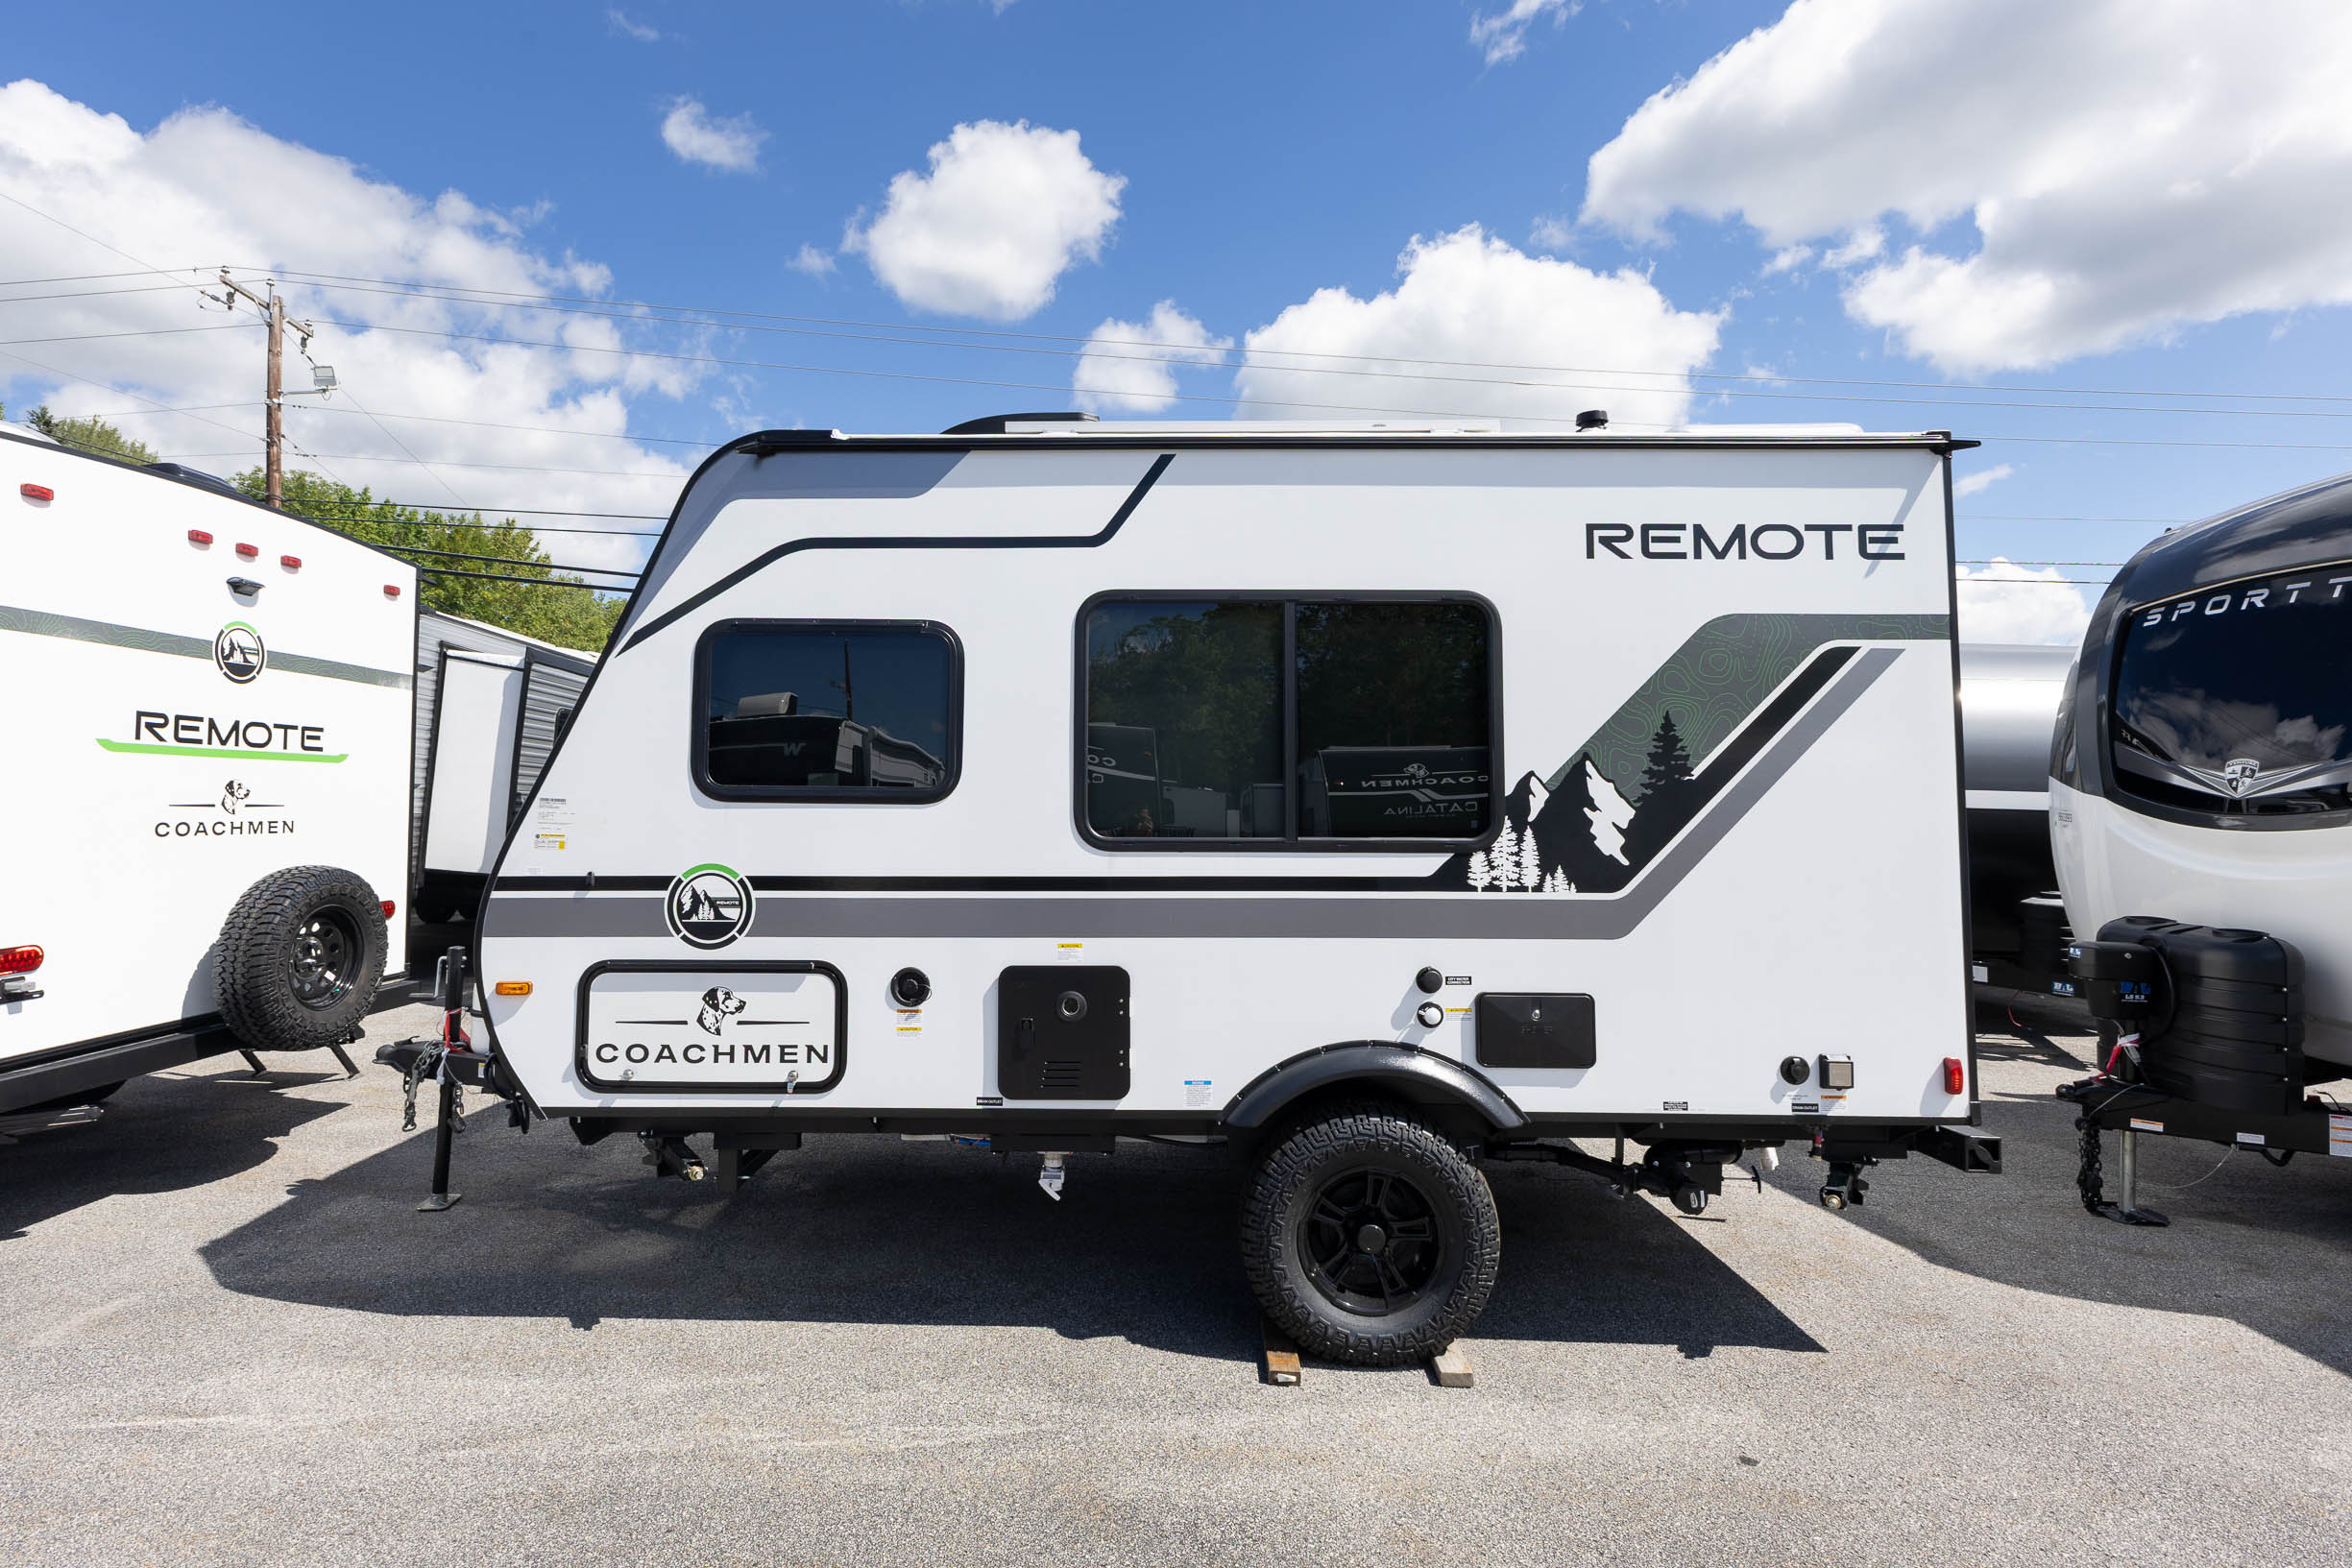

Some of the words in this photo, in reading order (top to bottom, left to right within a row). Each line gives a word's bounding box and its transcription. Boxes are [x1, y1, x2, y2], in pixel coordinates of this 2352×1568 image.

[1586, 523, 1905, 560] REMOTE
[135, 710, 325, 753] REMOTE
[154, 820, 296, 838] COACHMEN
[595, 1043, 828, 1063] COACHMEN
